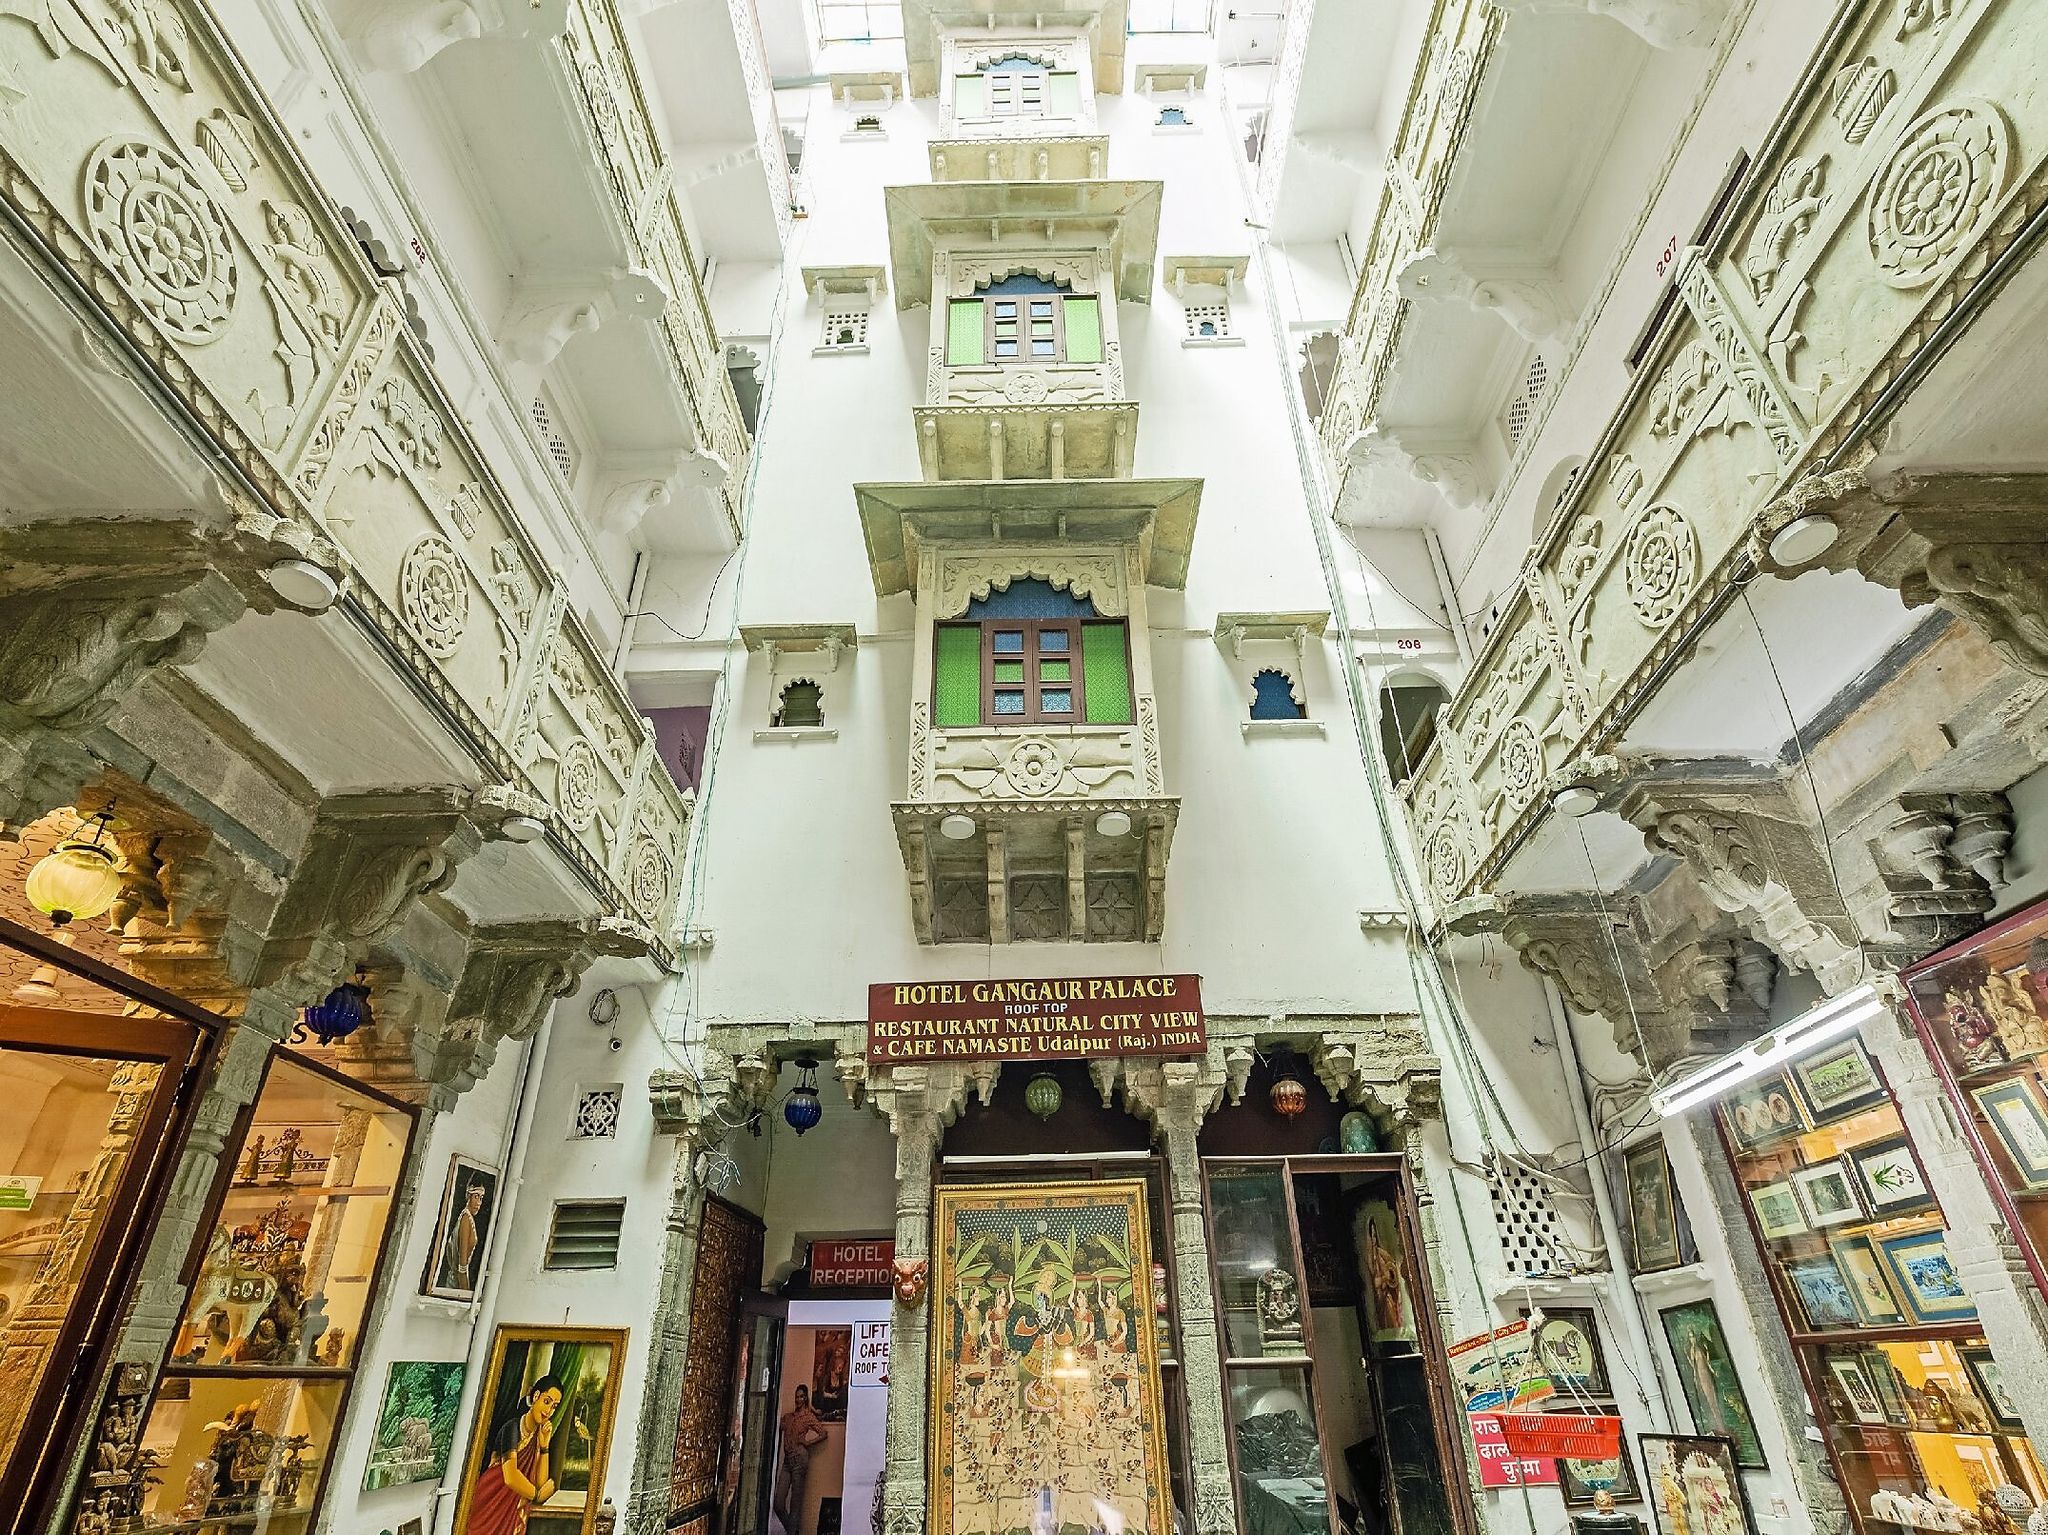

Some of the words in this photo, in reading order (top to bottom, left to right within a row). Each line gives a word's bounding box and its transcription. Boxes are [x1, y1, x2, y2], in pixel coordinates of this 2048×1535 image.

[1656, 235, 1676, 277] 207
[894, 984, 968, 1005] HOTEL
[972, 981, 1087, 1003] GANGAUR
[1089, 978, 1177, 1000] PALACE
[1005, 1004, 1039, 1015] ROOF
[1043, 1003, 1068, 1013] TOP
[874, 1018, 999, 1037] RESTAURANT
[1005, 1015, 1094, 1033] NATURAL
[1100, 1013, 1143, 1030] CITY
[1150, 1011, 1198, 1028] VIEW
[872, 1044, 882, 1055] &
[887, 1039, 937, 1056] CAFE
[943, 1036, 1032, 1055] NAMASTE
[1037, 1033, 1112, 1055] Udaipur
[1118, 1033, 1157, 1050] (Raj.)
[1161, 1031, 1201, 1046] INDIA
[834, 1246, 884, 1262] HOTEL
[814, 1268, 893, 1285] RECEPTIO
[861, 1324, 889, 1339] LIFT
[860, 1343, 889, 1358] CAFE
[855, 1362, 877, 1374] ROOF
